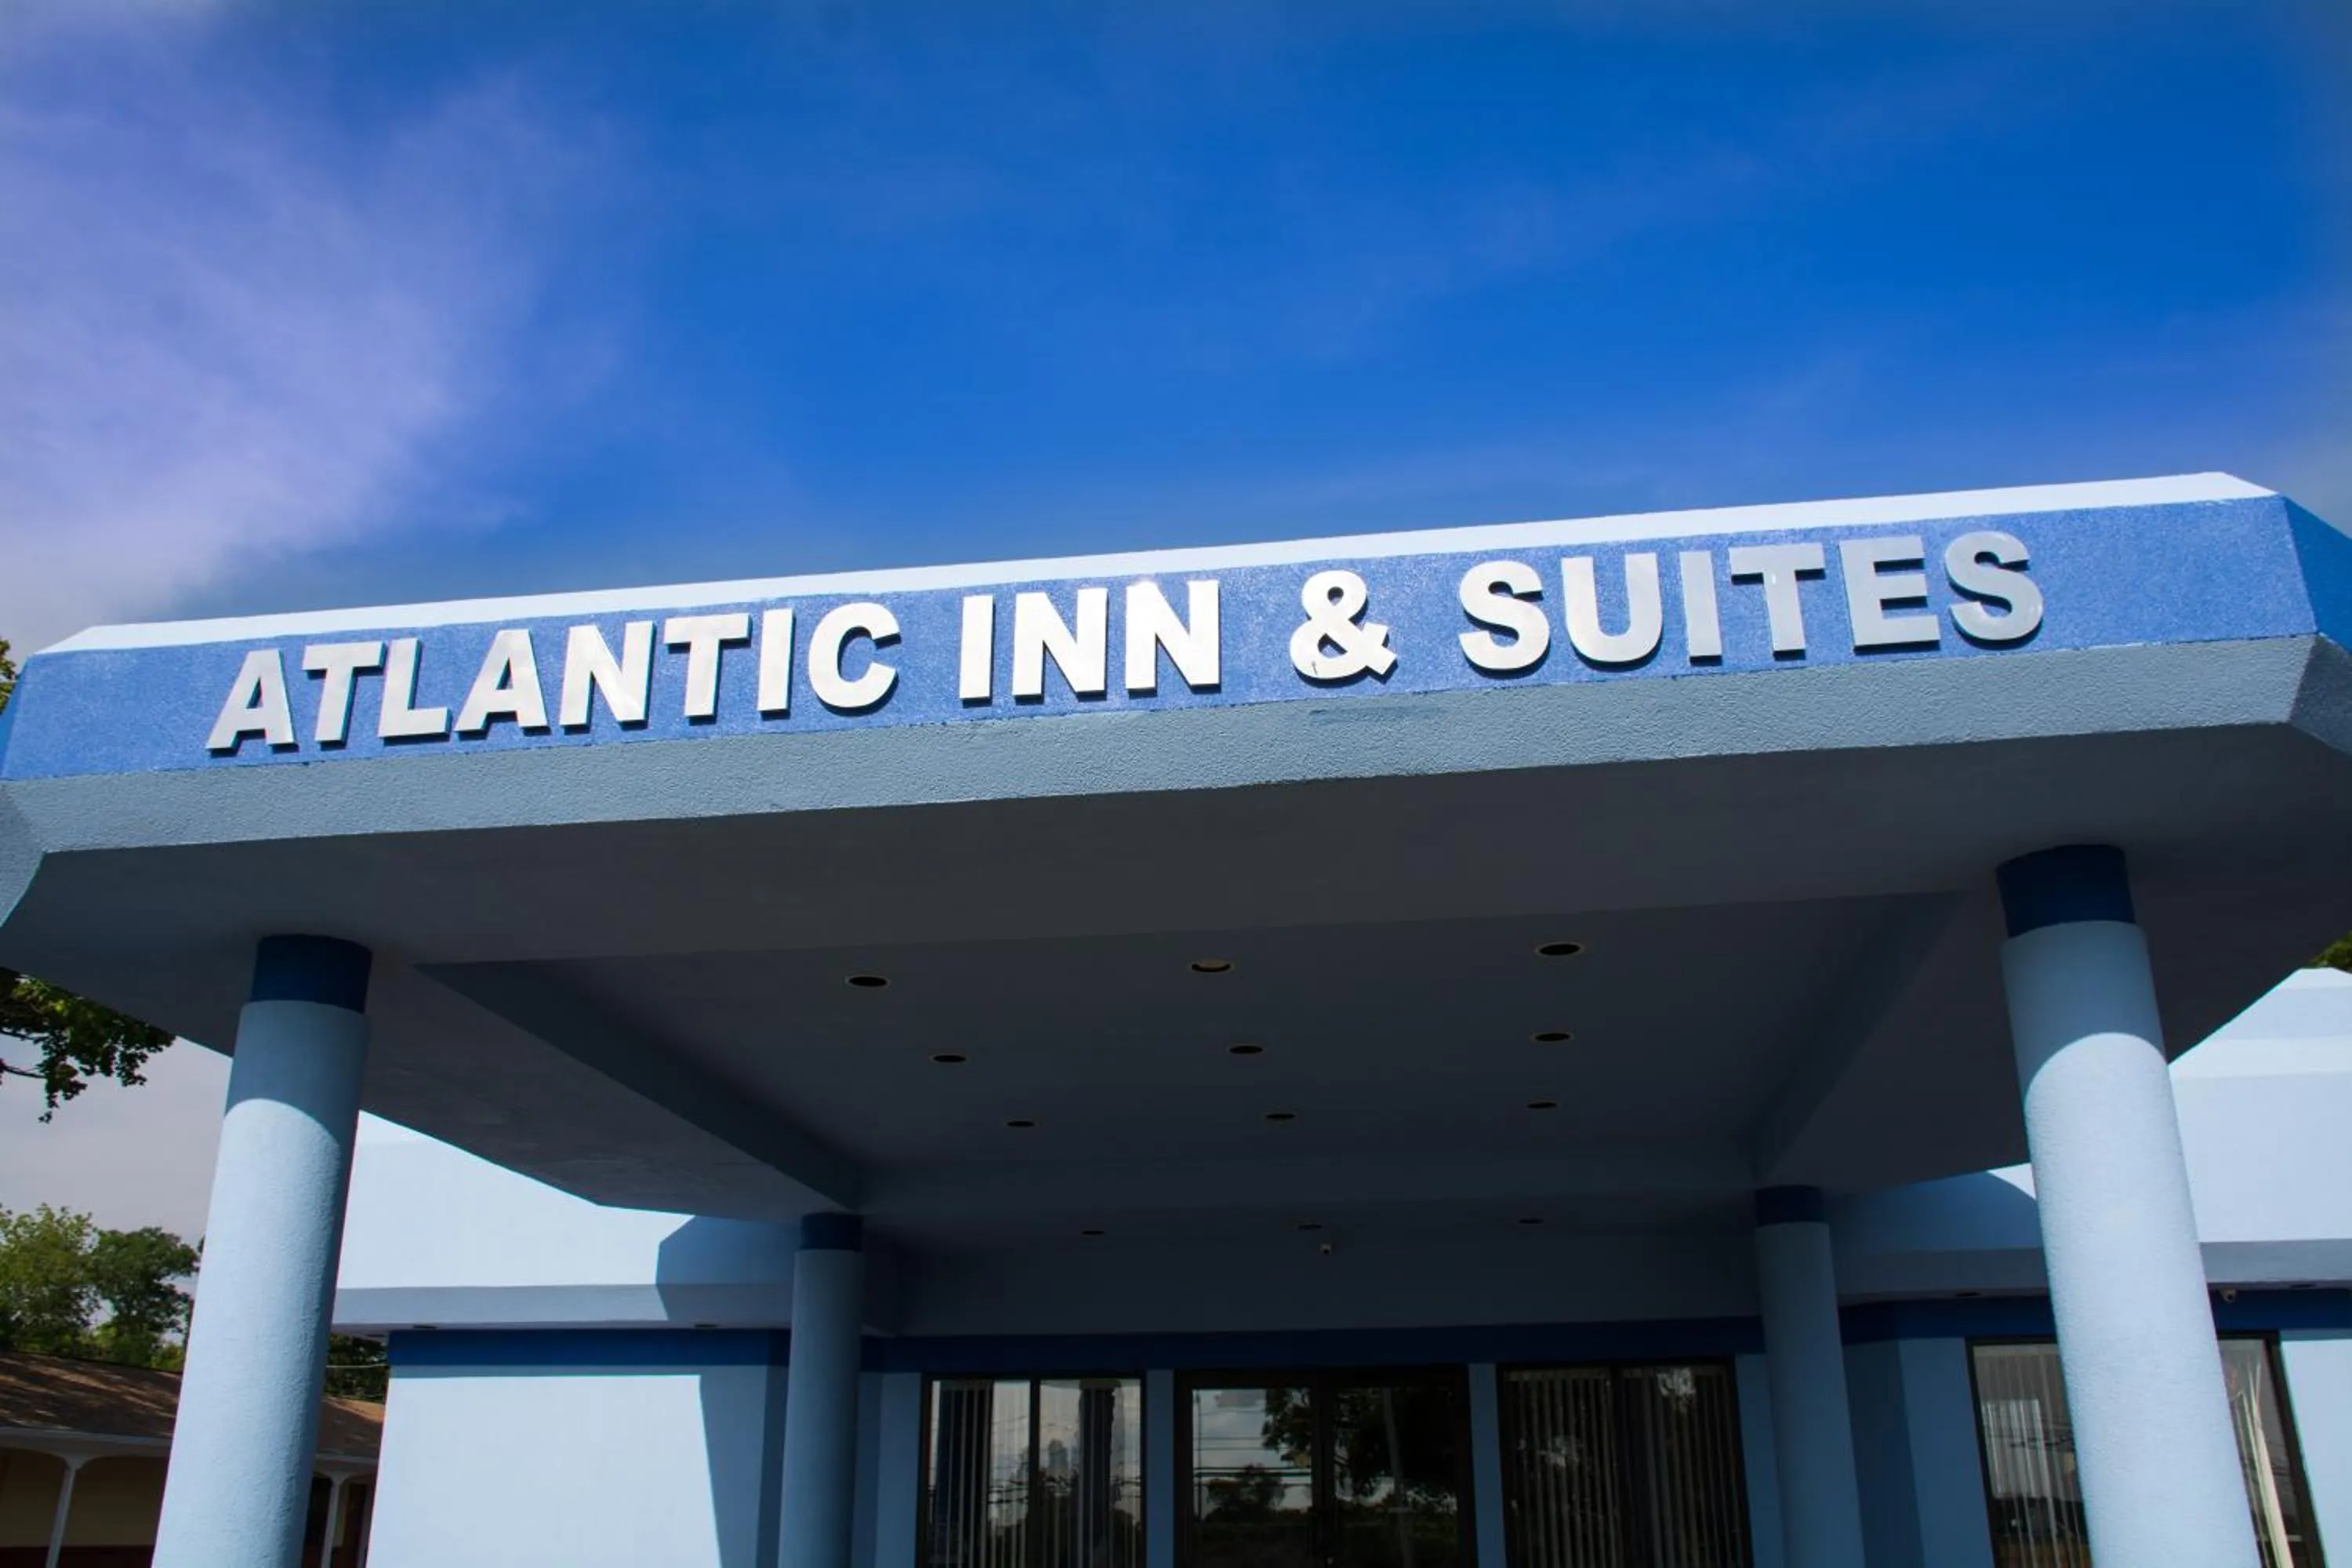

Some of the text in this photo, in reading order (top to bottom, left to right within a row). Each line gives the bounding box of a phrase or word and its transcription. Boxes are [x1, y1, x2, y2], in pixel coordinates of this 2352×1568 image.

[206, 531, 2043, 750] ATLANTIC INN & SUITES
